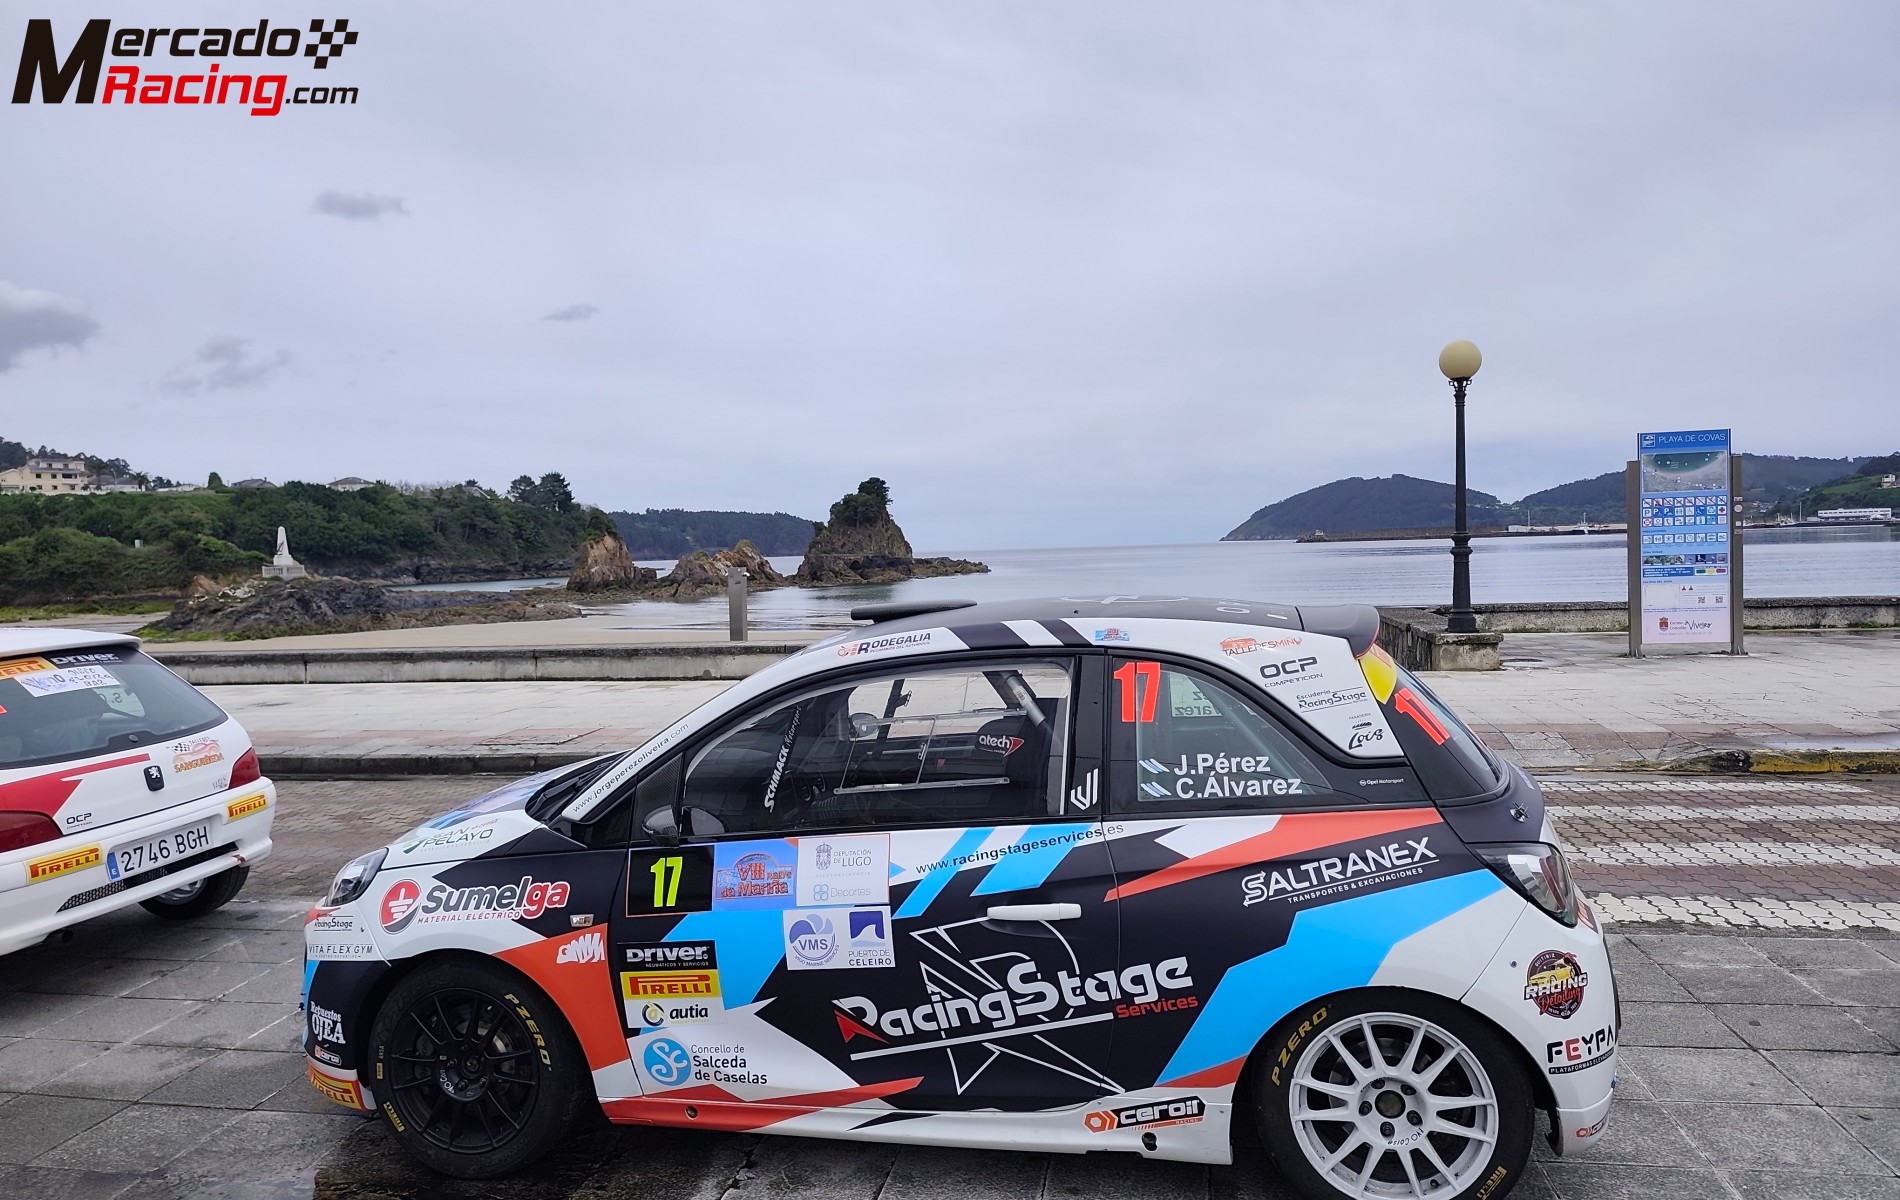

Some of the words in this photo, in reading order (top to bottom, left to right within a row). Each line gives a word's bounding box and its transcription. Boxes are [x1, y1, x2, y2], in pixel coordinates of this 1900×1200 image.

[1658, 435, 1684, 443] PLAYA
[1685, 434, 1696, 442] DE
[1697, 433, 1726, 442] COVAS
[857, 633, 931, 655] RODEGALIA
[1260, 656, 1318, 679] OCP
[1114, 662, 1161, 723] 17
[1299, 691, 1366, 710] RacingStage
[978, 734, 1011, 749] atech
[573, 723, 689, 813] www.jorgeperezoliveira.com
[1174, 752, 1271, 776] J.Pérez
[764, 745, 790, 813] SCHMACK
[1175, 771, 1303, 799] C.Álvarez
[228, 794, 267, 818] PIRELLI
[66, 812, 93, 825] OCP
[120, 839, 171, 873] 2746
[173, 825, 210, 855] BGH
[423, 828, 494, 848] PELAYO
[915, 823, 1125, 875] www.racingstageservices.es
[29, 847, 100, 879] PIRELLI
[833, 849, 872, 857] DEPUTACIÓN
[842, 856, 872, 867] LUGO
[111, 868, 118, 876] E
[650, 856, 683, 908] 17
[1241, 837, 1437, 907] SALTRANEX
[830, 886, 871, 899] Deportes
[1287, 884, 1349, 905] TRANSPORTES
[1351, 882, 1357, 890] &
[1358, 867, 1424, 889] EXCAVACIONES
[421, 876, 570, 919] Sumelga
[417, 914, 463, 925] MATERIAL
[465, 910, 521, 921] ELÉCTRICO
[309, 945, 324, 954] VITA
[326, 945, 352, 954] FLEX
[354, 945, 373, 954] GYM
[798, 938, 829, 951] VMS
[848, 949, 878, 958] PUERTO
[879, 949, 891, 957] DE
[848, 957, 892, 967] CELEIRO
[629, 974, 711, 996] PIRELLI
[1524, 972, 1588, 1000] RACING
[310, 1000, 342, 1023] Repuestos
[669, 1003, 709, 1020] autia
[1115, 996, 1199, 1018] Services
[312, 1013, 347, 1045] OJEA
[691, 1044, 731, 1054] Concello
[733, 1043, 745, 1054] de
[1546, 1024, 1615, 1064] FEYPA
[692, 1055, 747, 1069] Salceda
[1549, 1060, 1593, 1074] PLATAFORMAS
[694, 1069, 711, 1081] de
[713, 1070, 768, 1085] Caselas
[1119, 1099, 1200, 1125] ceroil
